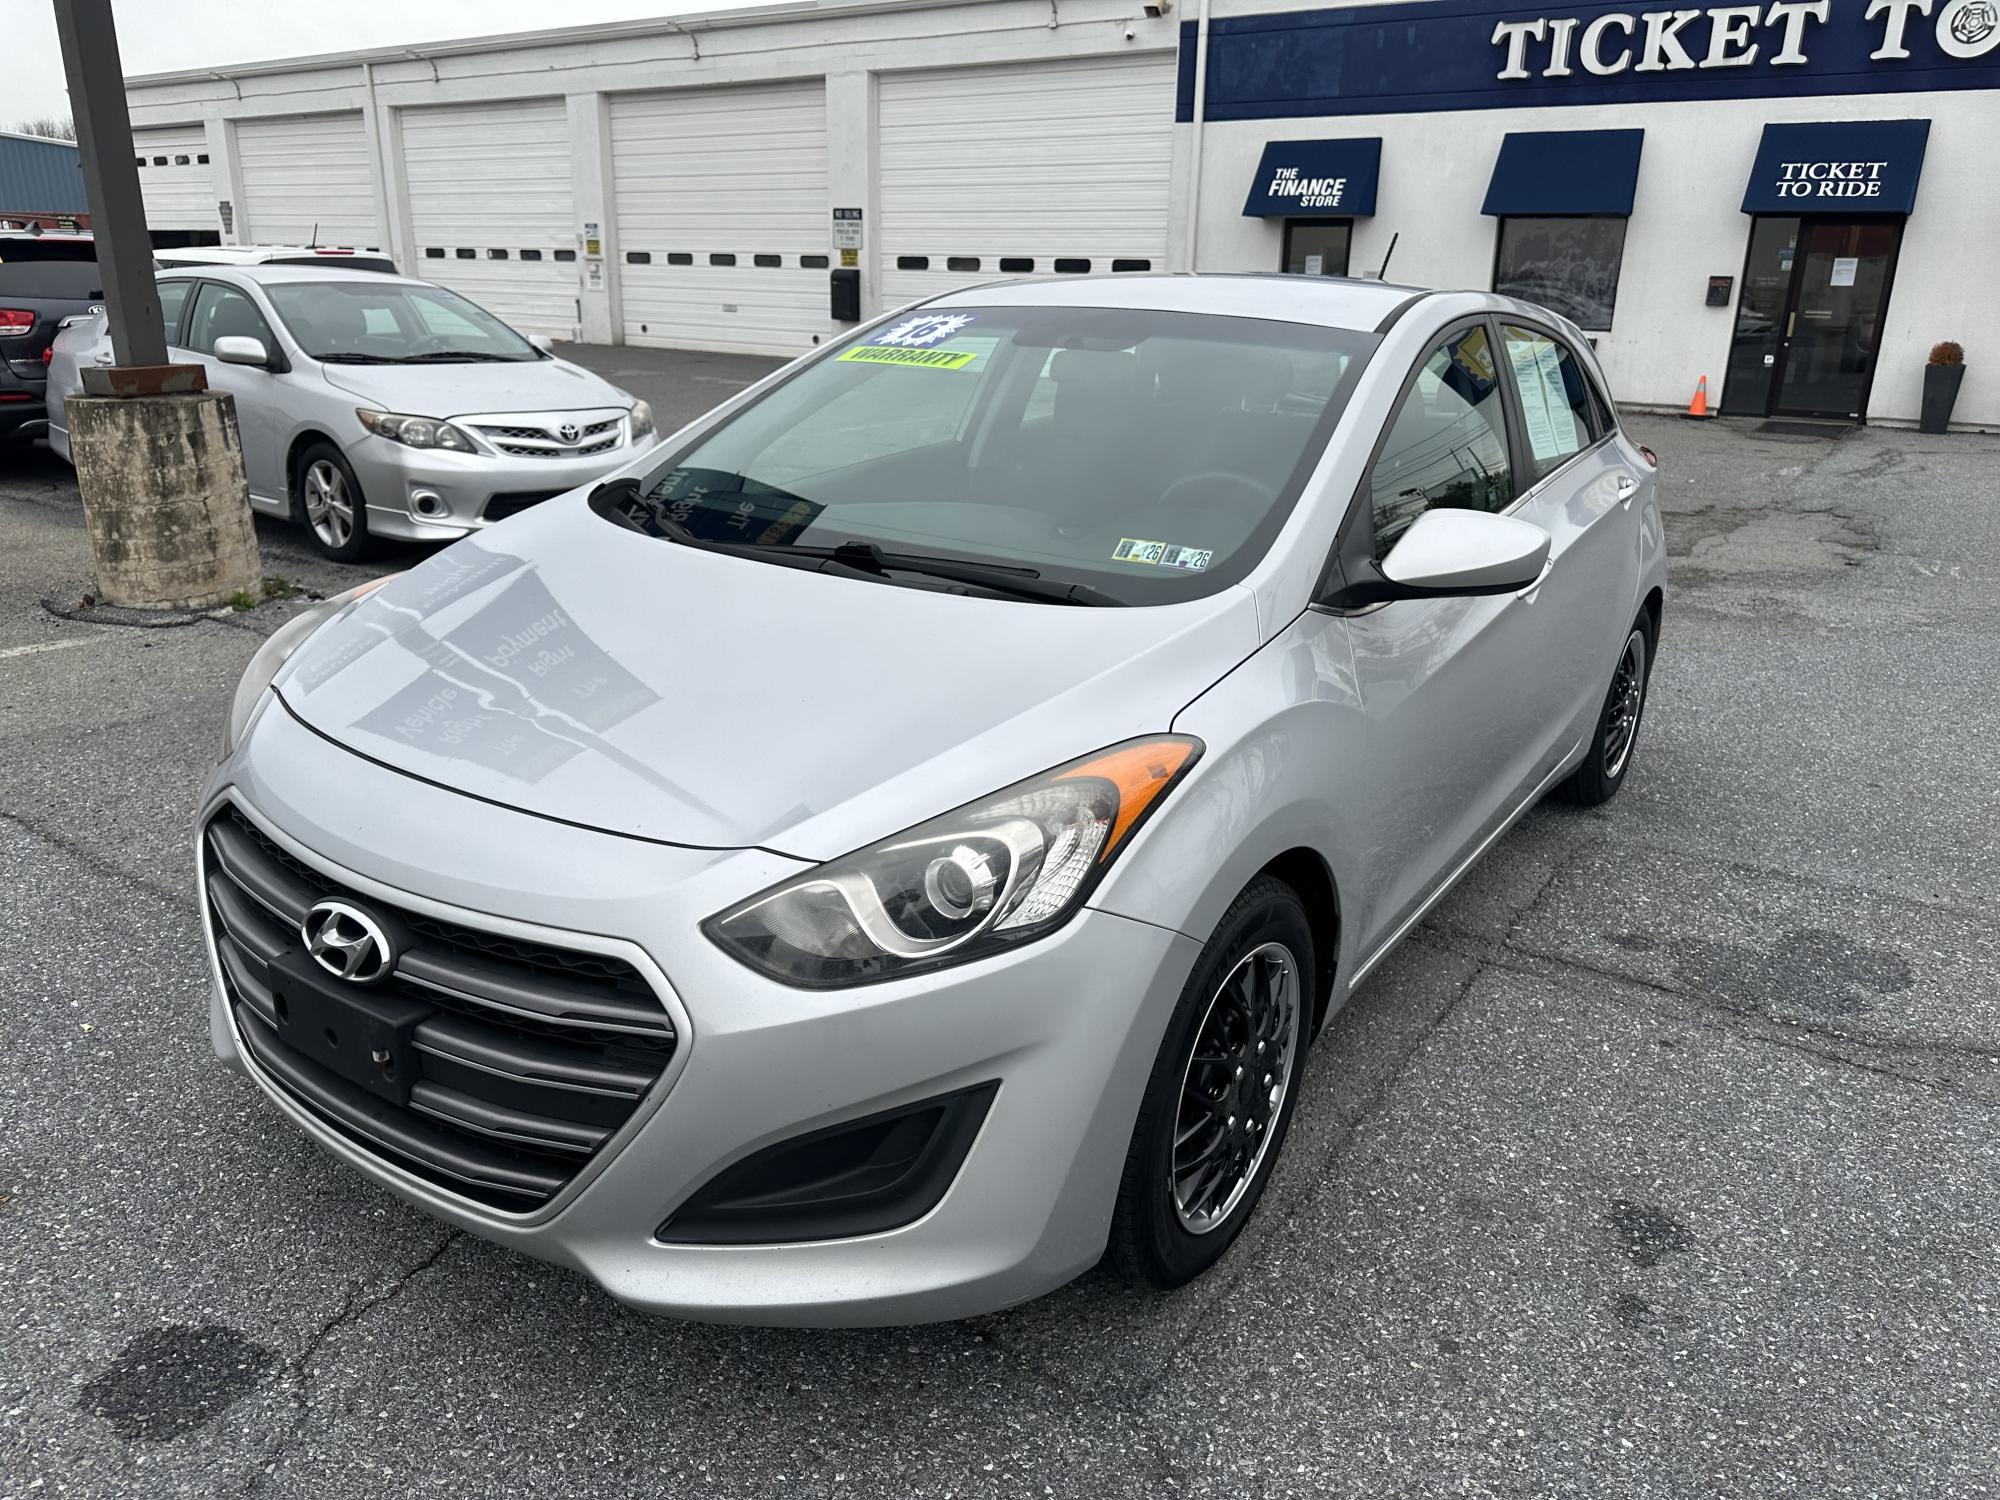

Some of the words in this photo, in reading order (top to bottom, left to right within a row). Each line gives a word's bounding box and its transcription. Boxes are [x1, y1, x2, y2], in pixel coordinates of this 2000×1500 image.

[1491, 0, 1830, 80] TICKET
[1864, 0, 2000, 60] TO
[1275, 167, 1299, 180] THE
[1780, 161, 1888, 180] TICKET
[1267, 178, 1347, 196] FINANCE
[1775, 181, 1812, 197] TO
[1816, 181, 1881, 197] RIDE
[1300, 195, 1341, 207] STORE
[849, 347, 968, 365] WARRANTY
[1146, 544, 1163, 561] 26
[1193, 551, 1210, 568] 26
